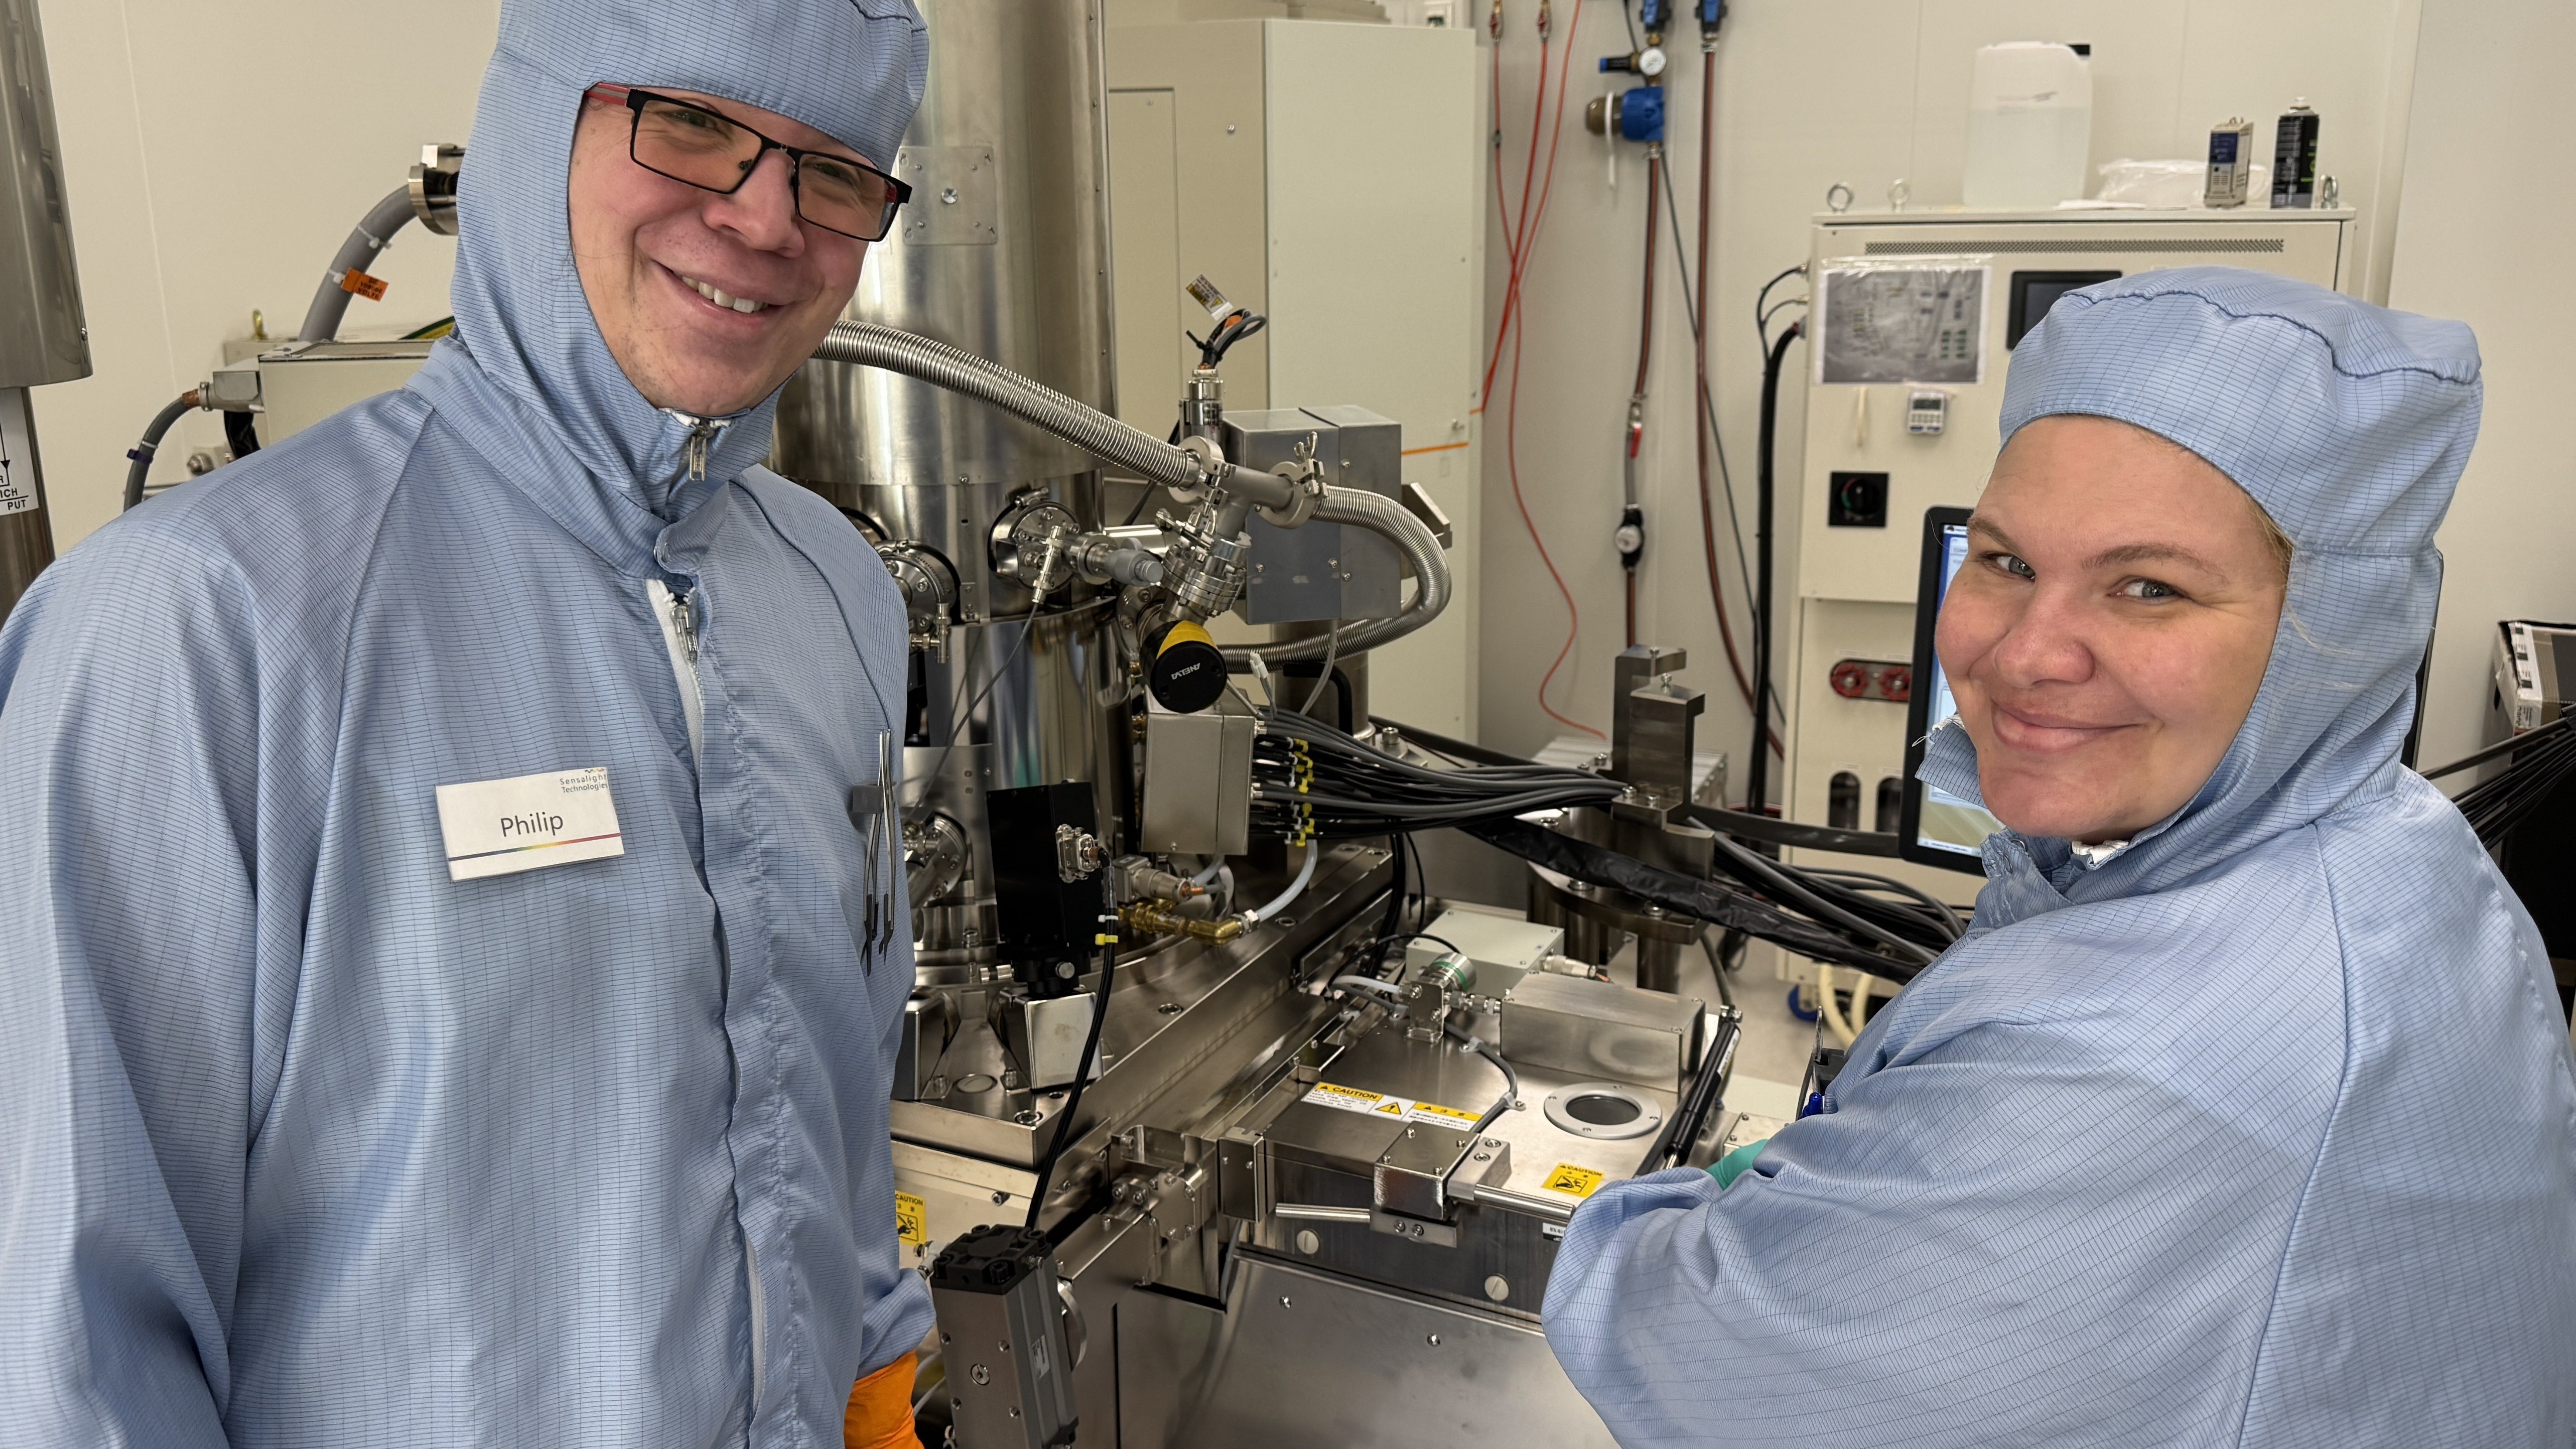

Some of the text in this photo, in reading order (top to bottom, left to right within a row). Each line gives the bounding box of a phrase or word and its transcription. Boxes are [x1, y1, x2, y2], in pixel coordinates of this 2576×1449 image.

[7, 499, 26, 510] PUT
[1171, 663, 1200, 680] ANELVA
[500, 812, 563, 837] Philip
[1332, 1087, 1378, 1099] CAUTION
[1567, 1165, 1602, 1176] CAUTION
[895, 1194, 923, 1206] CAUTION
